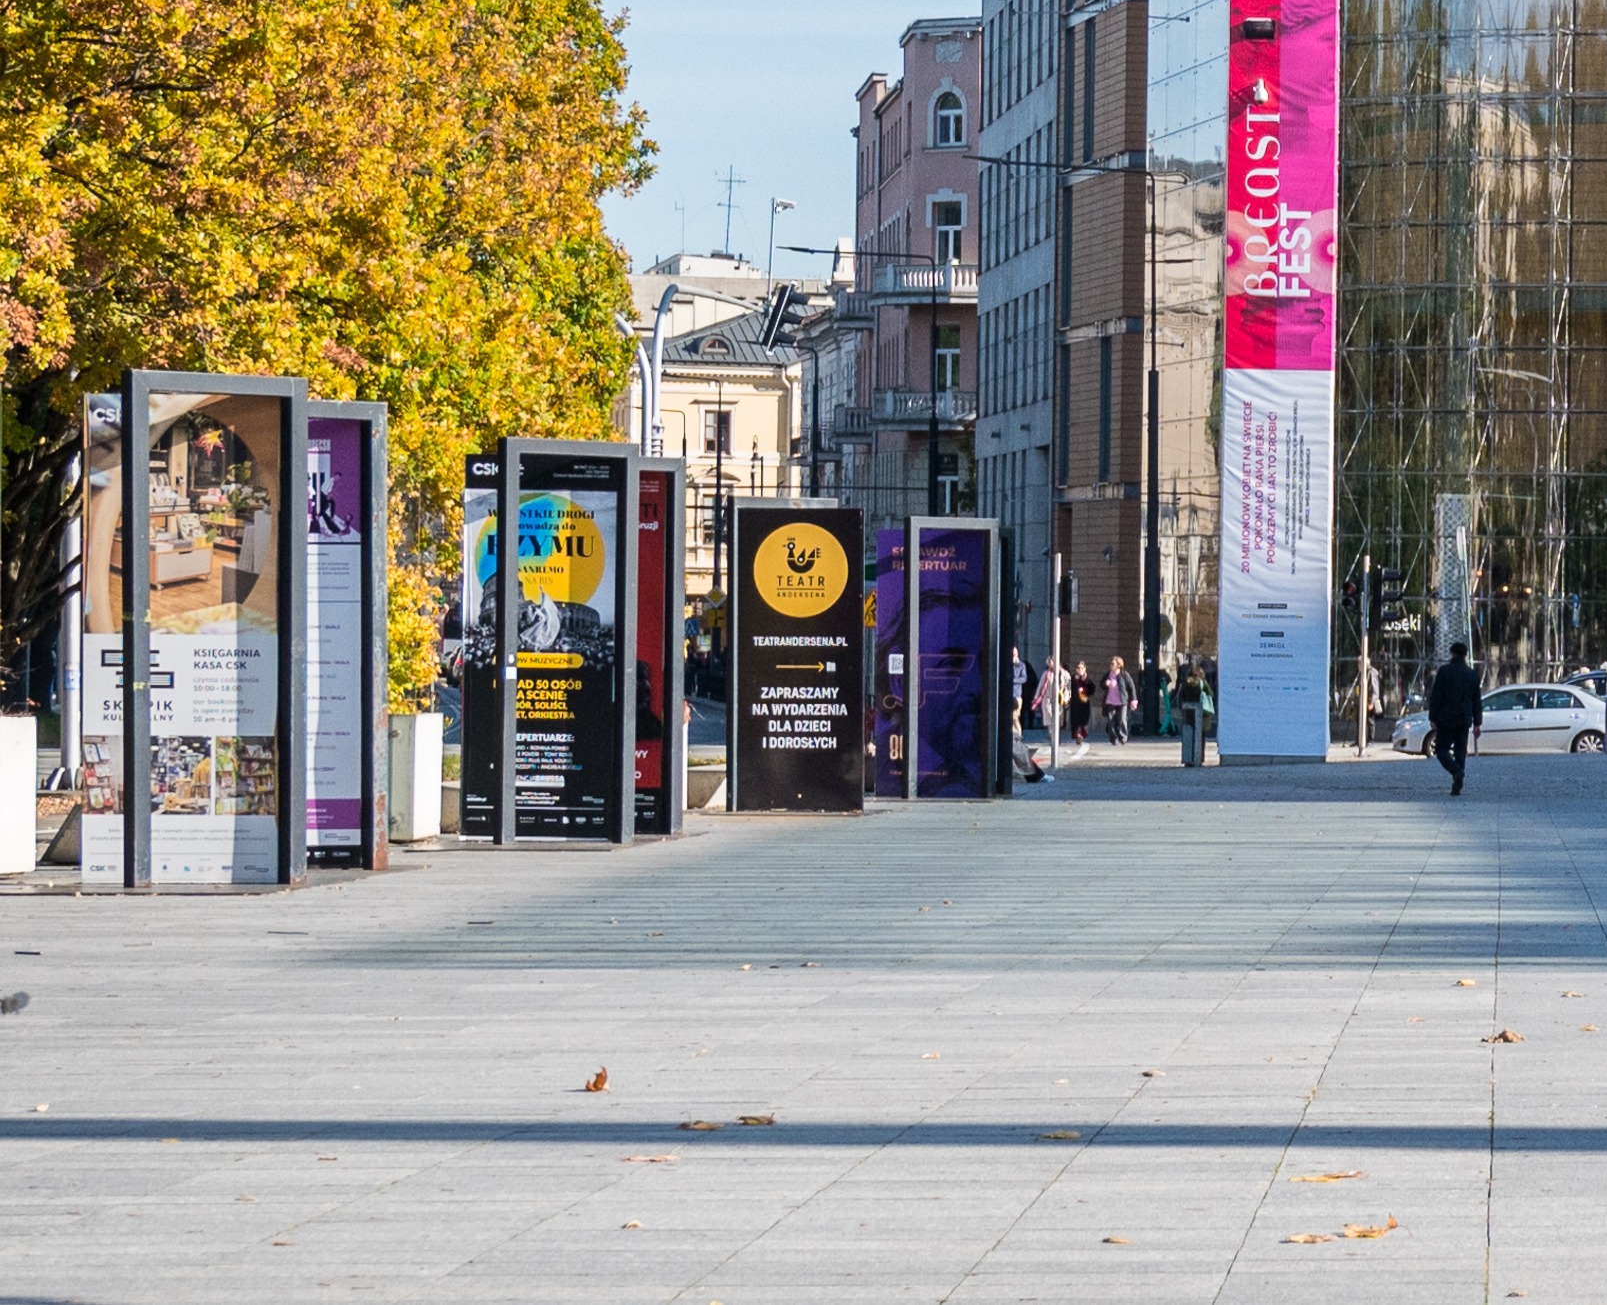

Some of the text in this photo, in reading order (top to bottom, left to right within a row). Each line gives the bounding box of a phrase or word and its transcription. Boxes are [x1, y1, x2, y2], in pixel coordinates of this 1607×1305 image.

[1279, 202, 1312, 298] FEST
[1243, 445, 1251, 461] NA
[1268, 455, 1277, 469] TO
[1255, 459, 1264, 488] RAKA
[1242, 462, 1252, 500] KOBIET
[1268, 471, 1277, 490] JAK
[1268, 493, 1277, 503] CI
[557, 509, 594, 520] DROGI
[1254, 489, 1264, 550] POKONAŁO
[562, 522, 576, 531] do
[892, 560, 967, 571] RERTUAR
[1241, 561, 1251, 574] 20
[777, 576, 825, 586] TEATR
[753, 636, 848, 646] TEATRANDERSENA.PL
[193, 649, 261, 658] KSIĘGARNIA
[193, 661, 247, 669] KASA CSK
[536, 680, 549, 689] 50
[551, 679, 582, 690] OSÓB
[526, 690, 567, 700] SCENIE:
[761, 687, 839, 699] ZAPRASZAMY
[528, 710, 575, 719] ORKIESTRA
[752, 703, 848, 715] NA WYDARZENIA
[768, 720, 831, 732] DLA DZIECI
[516, 734, 575, 742] EPERTUARZE:
[762, 736, 837, 748] I DOROSŁYCH
